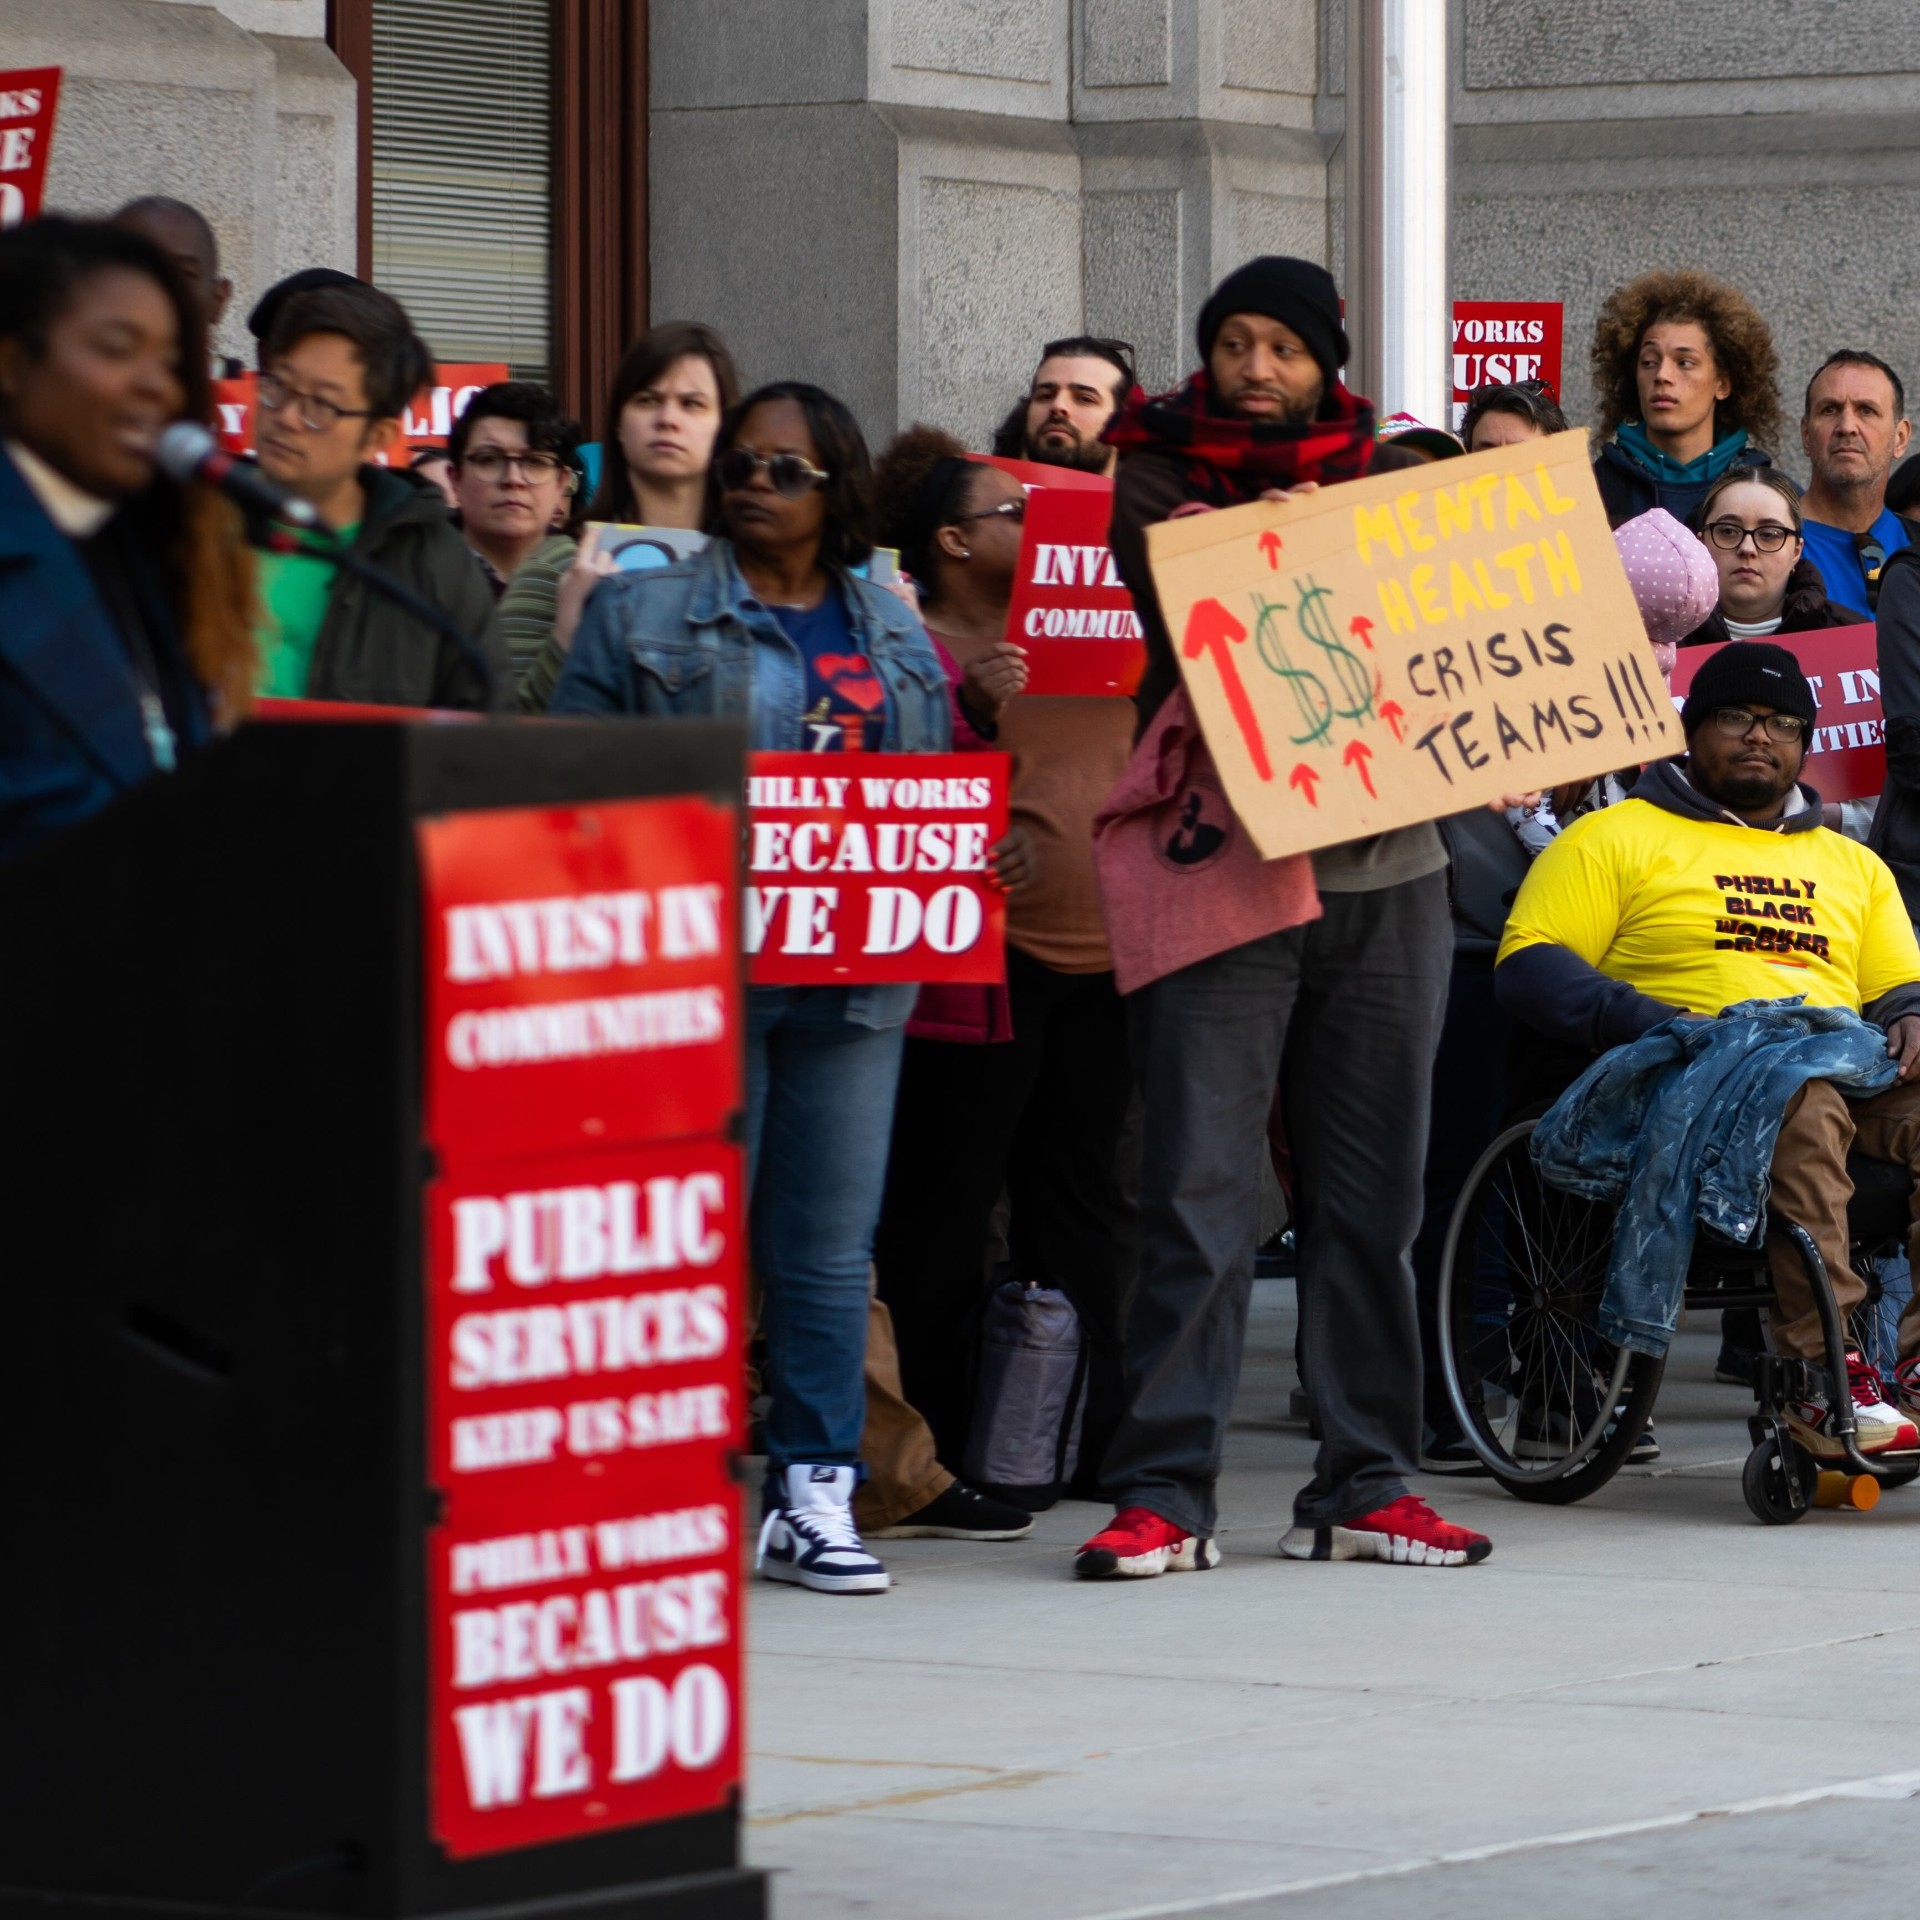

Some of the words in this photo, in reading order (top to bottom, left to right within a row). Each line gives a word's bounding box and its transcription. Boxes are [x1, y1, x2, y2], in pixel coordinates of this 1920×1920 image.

[1354, 462, 1576, 565] MENTAL
[1377, 530, 1582, 634] HEALTH
[1407, 622, 1575, 701] CRISIS
[859, 777, 991, 809] WORKS
[447, 890, 650, 983] INVEST
[656, 884, 722, 962] IN
[861, 885, 982, 954] DO
[1713, 874, 1817, 899] PHILLY
[1725, 896, 1816, 926] BLACK
[452, 1172, 724, 1293] PUBLIC
[452, 1285, 727, 1389] SERVICES
[566, 1397, 624, 1457] US
[452, 1525, 592, 1594] PHILLY
[597, 1504, 728, 1569] WORKS
[453, 1571, 728, 1689] BECAUSE
[453, 1687, 593, 1809] WE
[609, 1663, 730, 1784] DO
